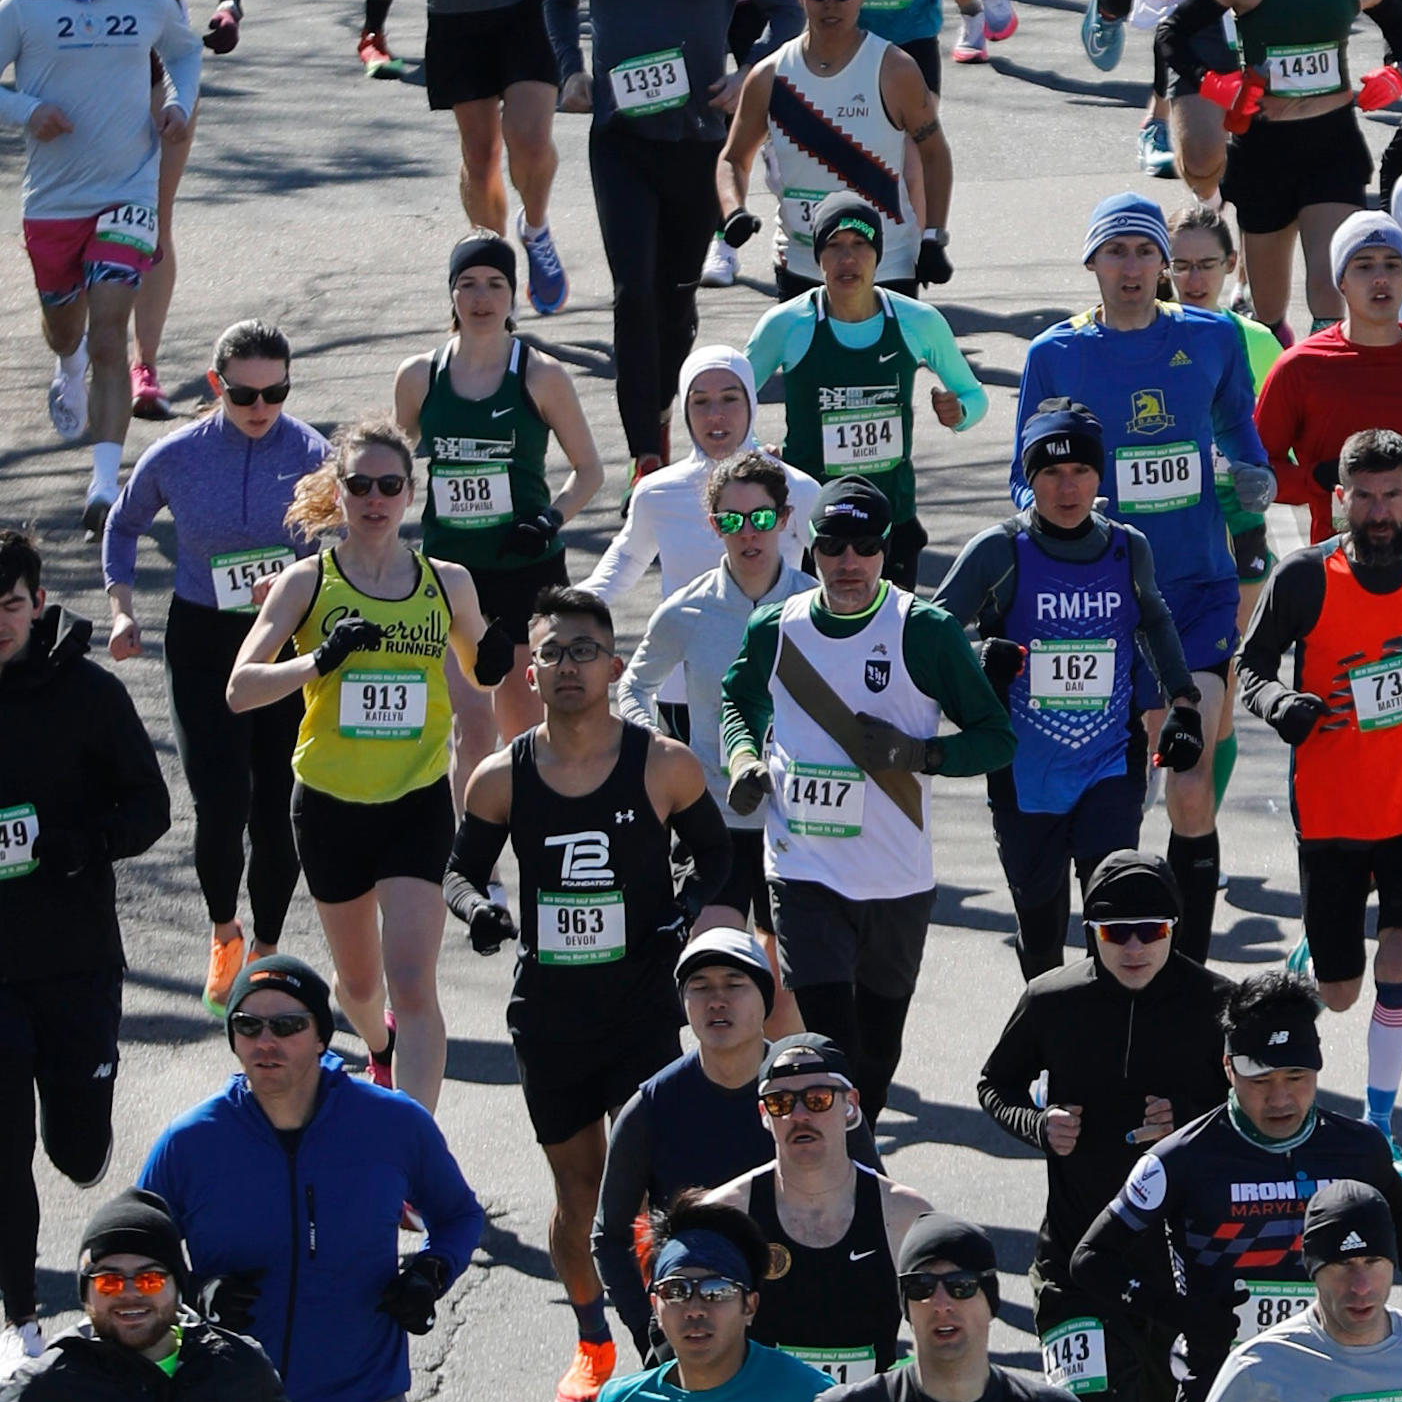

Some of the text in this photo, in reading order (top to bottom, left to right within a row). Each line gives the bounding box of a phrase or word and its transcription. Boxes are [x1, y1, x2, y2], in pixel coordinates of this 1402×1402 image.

[1278, 53, 1330, 79] 1430
[621, 68, 678, 94] 1333
[836, 105, 870, 118] ZUNI
[110, 203, 157, 233] 1425
[836, 421, 892, 449] 1384
[1130, 458, 1189, 485] 1508
[450, 478, 493, 503] 368
[1036, 592, 1123, 621] RMHP
[323, 605, 453, 649] Serville
[386, 640, 445, 659] RUNNERS
[1051, 654, 1098, 681] 162
[361, 684, 409, 711] 913
[1064, 681, 1084, 693] DAN
[363, 711, 405, 724] KATELYN
[790, 776, 852, 809] 1417
[561, 879, 615, 887] FOUNDATION
[557, 906, 604, 934] 963
[565, 935, 598, 947] DEVON
[1230, 1200, 1306, 1219] MARYLA
